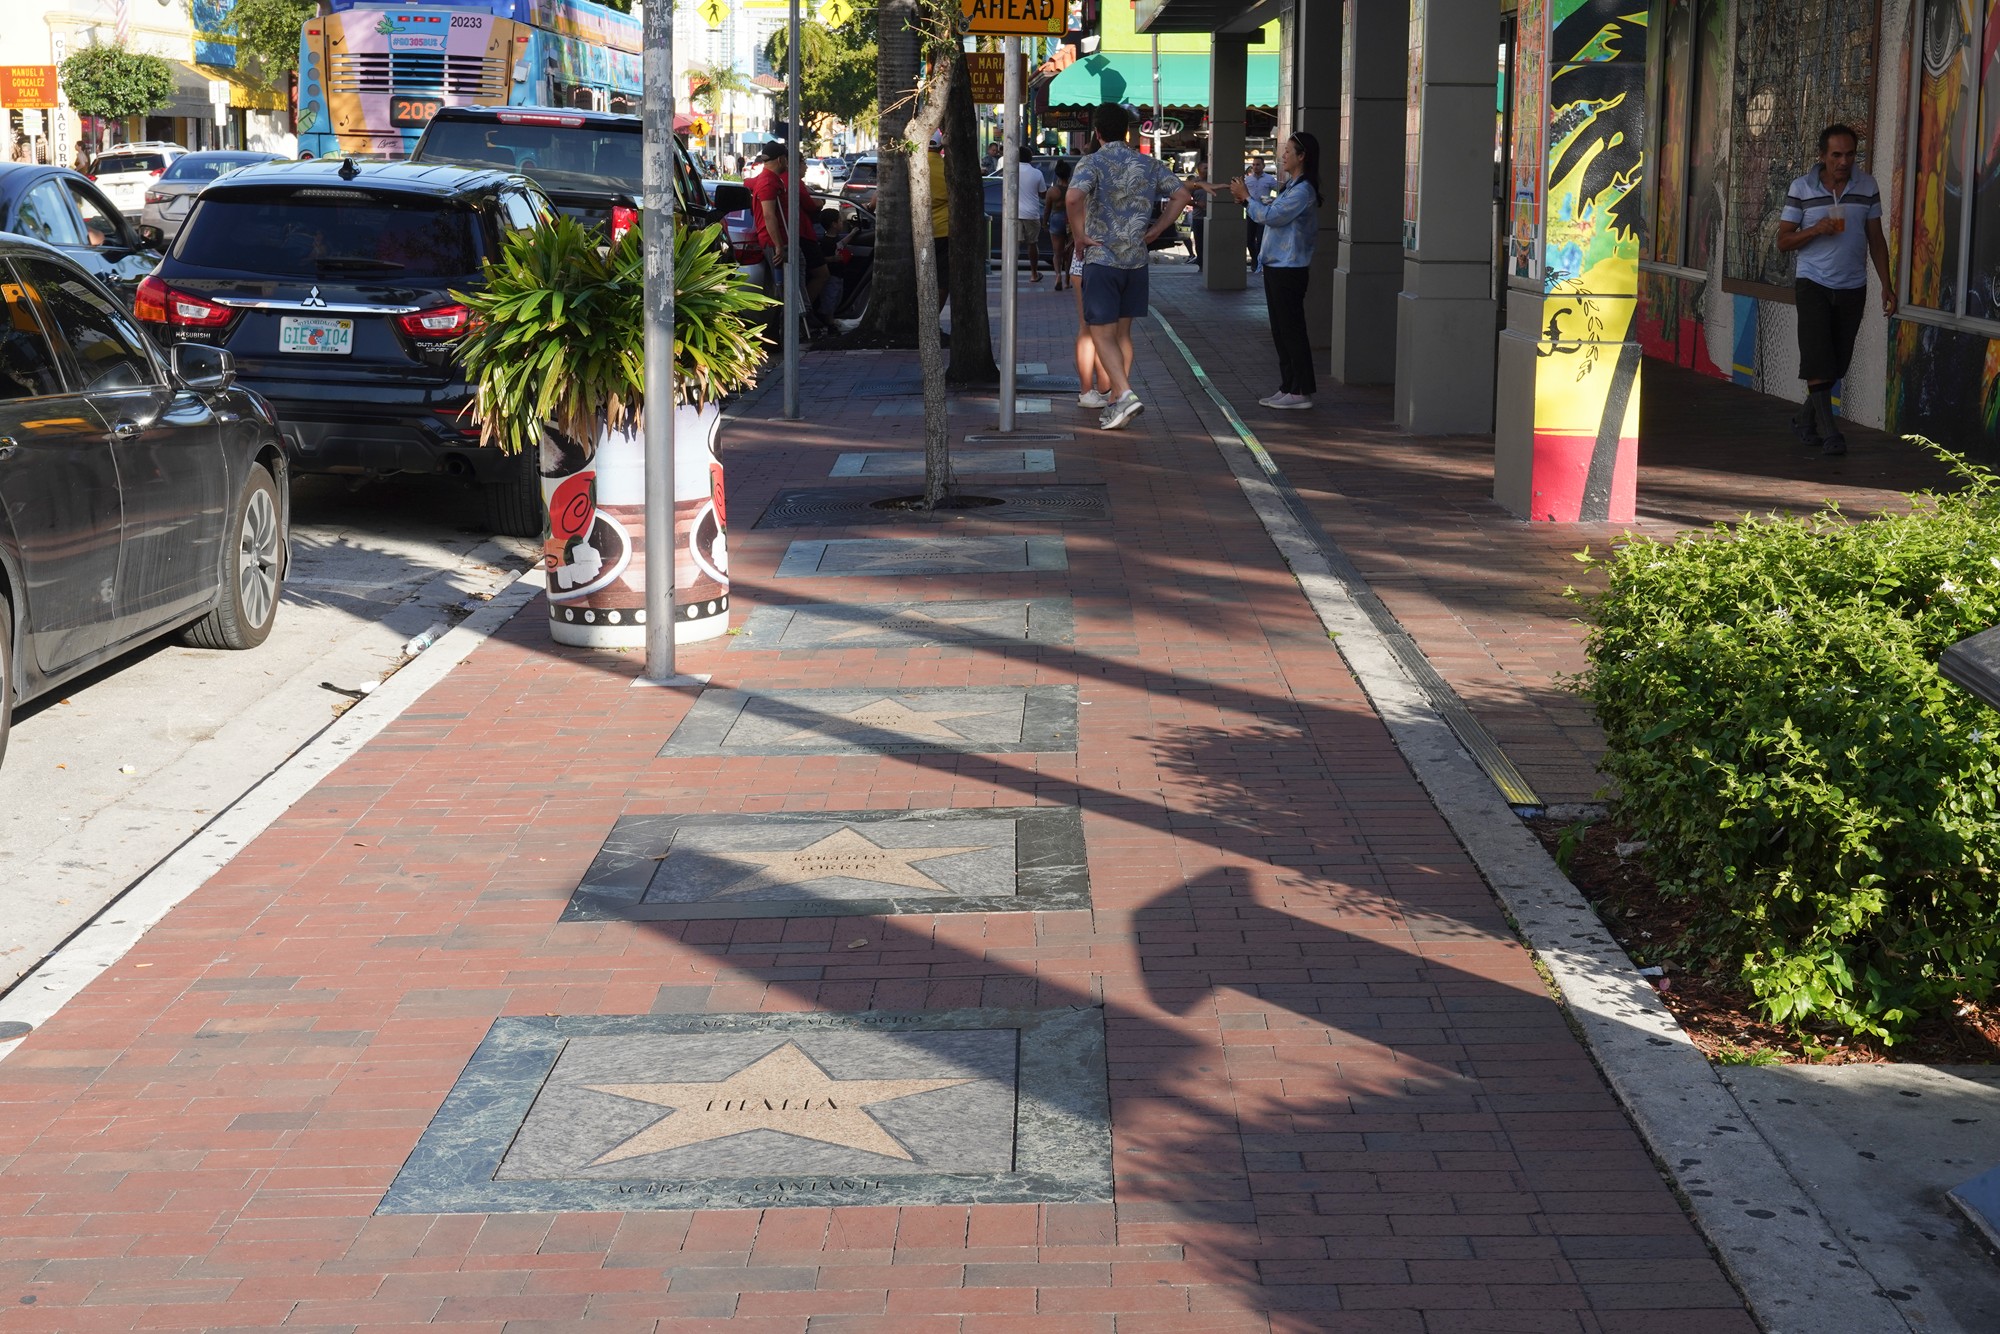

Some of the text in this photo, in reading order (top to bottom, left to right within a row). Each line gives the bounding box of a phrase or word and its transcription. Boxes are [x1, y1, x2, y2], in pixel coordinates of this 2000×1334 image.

[973, 0, 1055, 20] AHEAD
[450, 16, 482, 28] 20233
[393, 37, 438, 46] #GO305BUS
[12, 68, 45, 77] MANUEL A
[12, 78, 45, 87] GONZALEZ
[18, 88, 39, 97] PLAZA
[397, 101, 437, 119] 208
[1142, 120, 1179, 134] OEN
[283, 327, 310, 344] GIE
[793, 854, 886, 862] ROBERTO
[800, 863, 877, 871] TORRES
[863, 1015, 923, 1024] OCHO
[703, 1097, 839, 1111] THALIA
[609, 1180, 884, 1194] ACTRI CANTANTE
